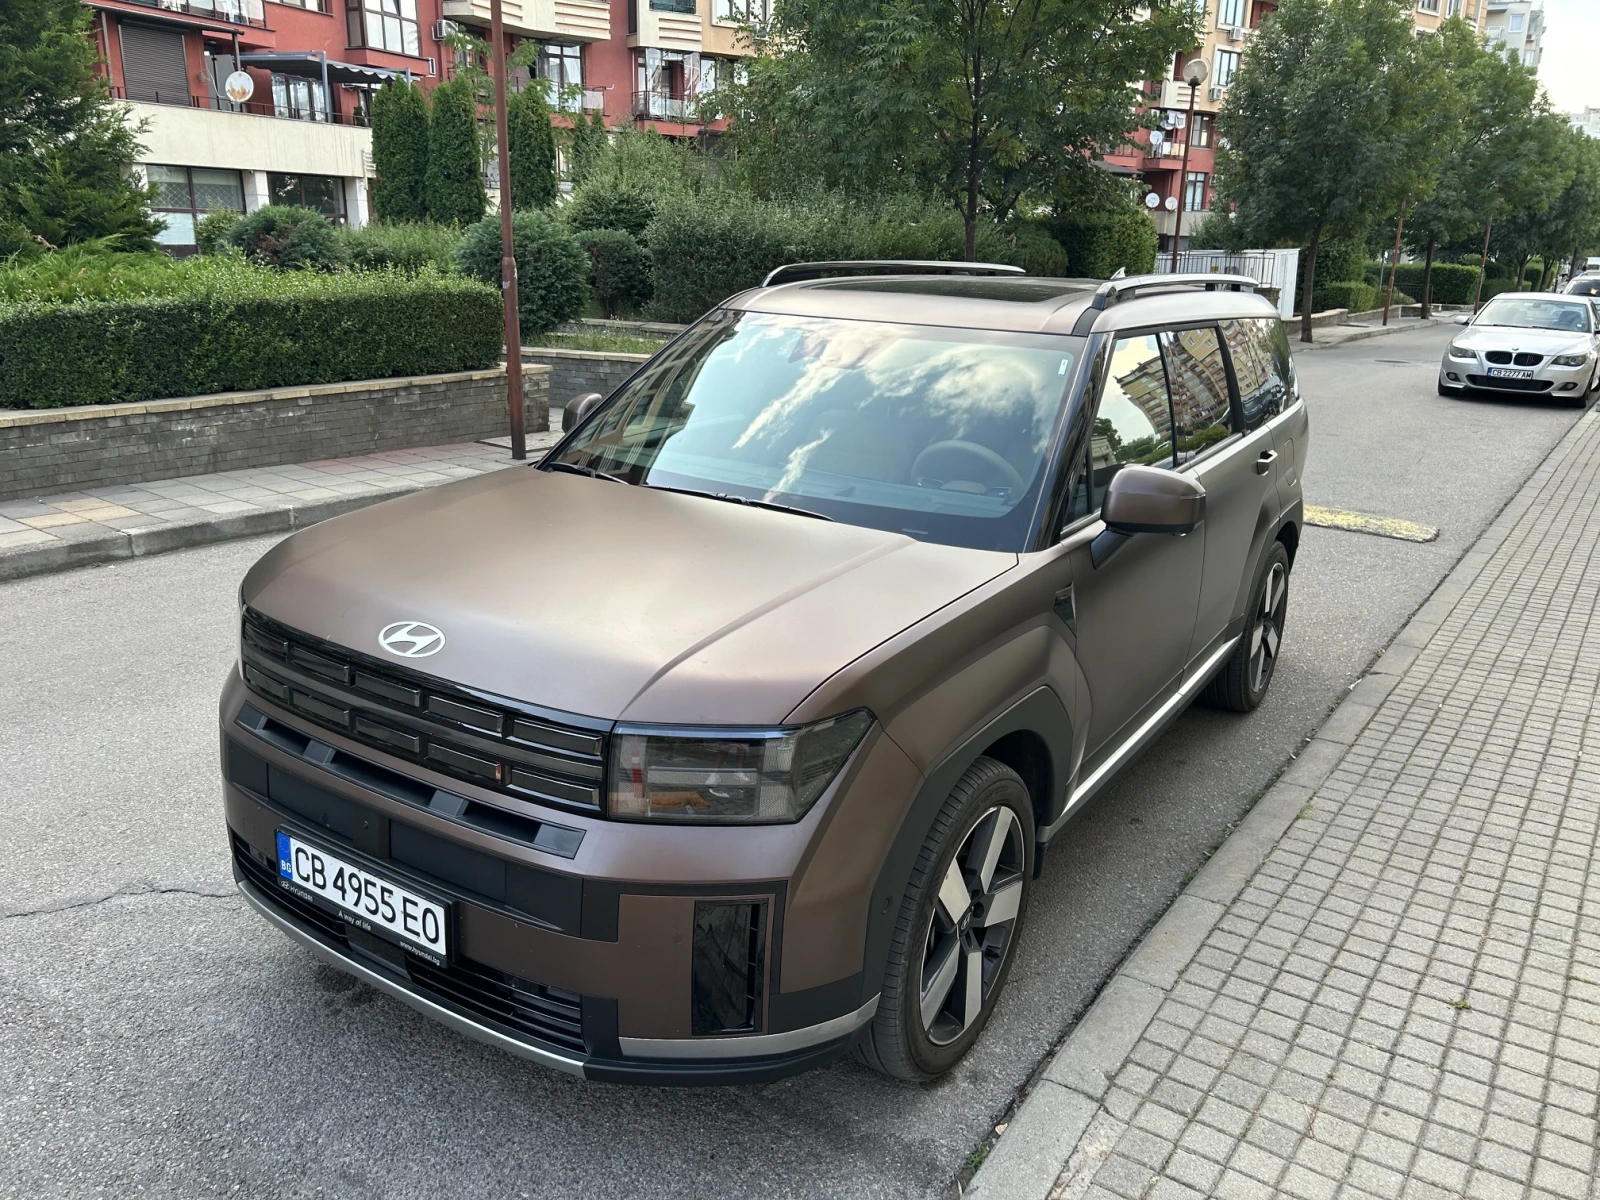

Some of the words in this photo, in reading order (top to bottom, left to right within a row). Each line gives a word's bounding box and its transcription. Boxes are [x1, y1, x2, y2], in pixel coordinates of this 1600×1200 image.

[1503, 370, 1520, 378] 2277
[281, 860, 292, 873] BG
[290, 885, 313, 902] HYUNDAI
[295, 847, 327, 890] CB
[333, 867, 397, 923] 4955
[402, 896, 440, 944] EO
[338, 910, 344, 918] A
[344, 913, 354, 924] way
[355, 919, 362, 927] of
[362, 921, 372, 931] life
[400, 940, 440, 966] www.hyundai.bg
